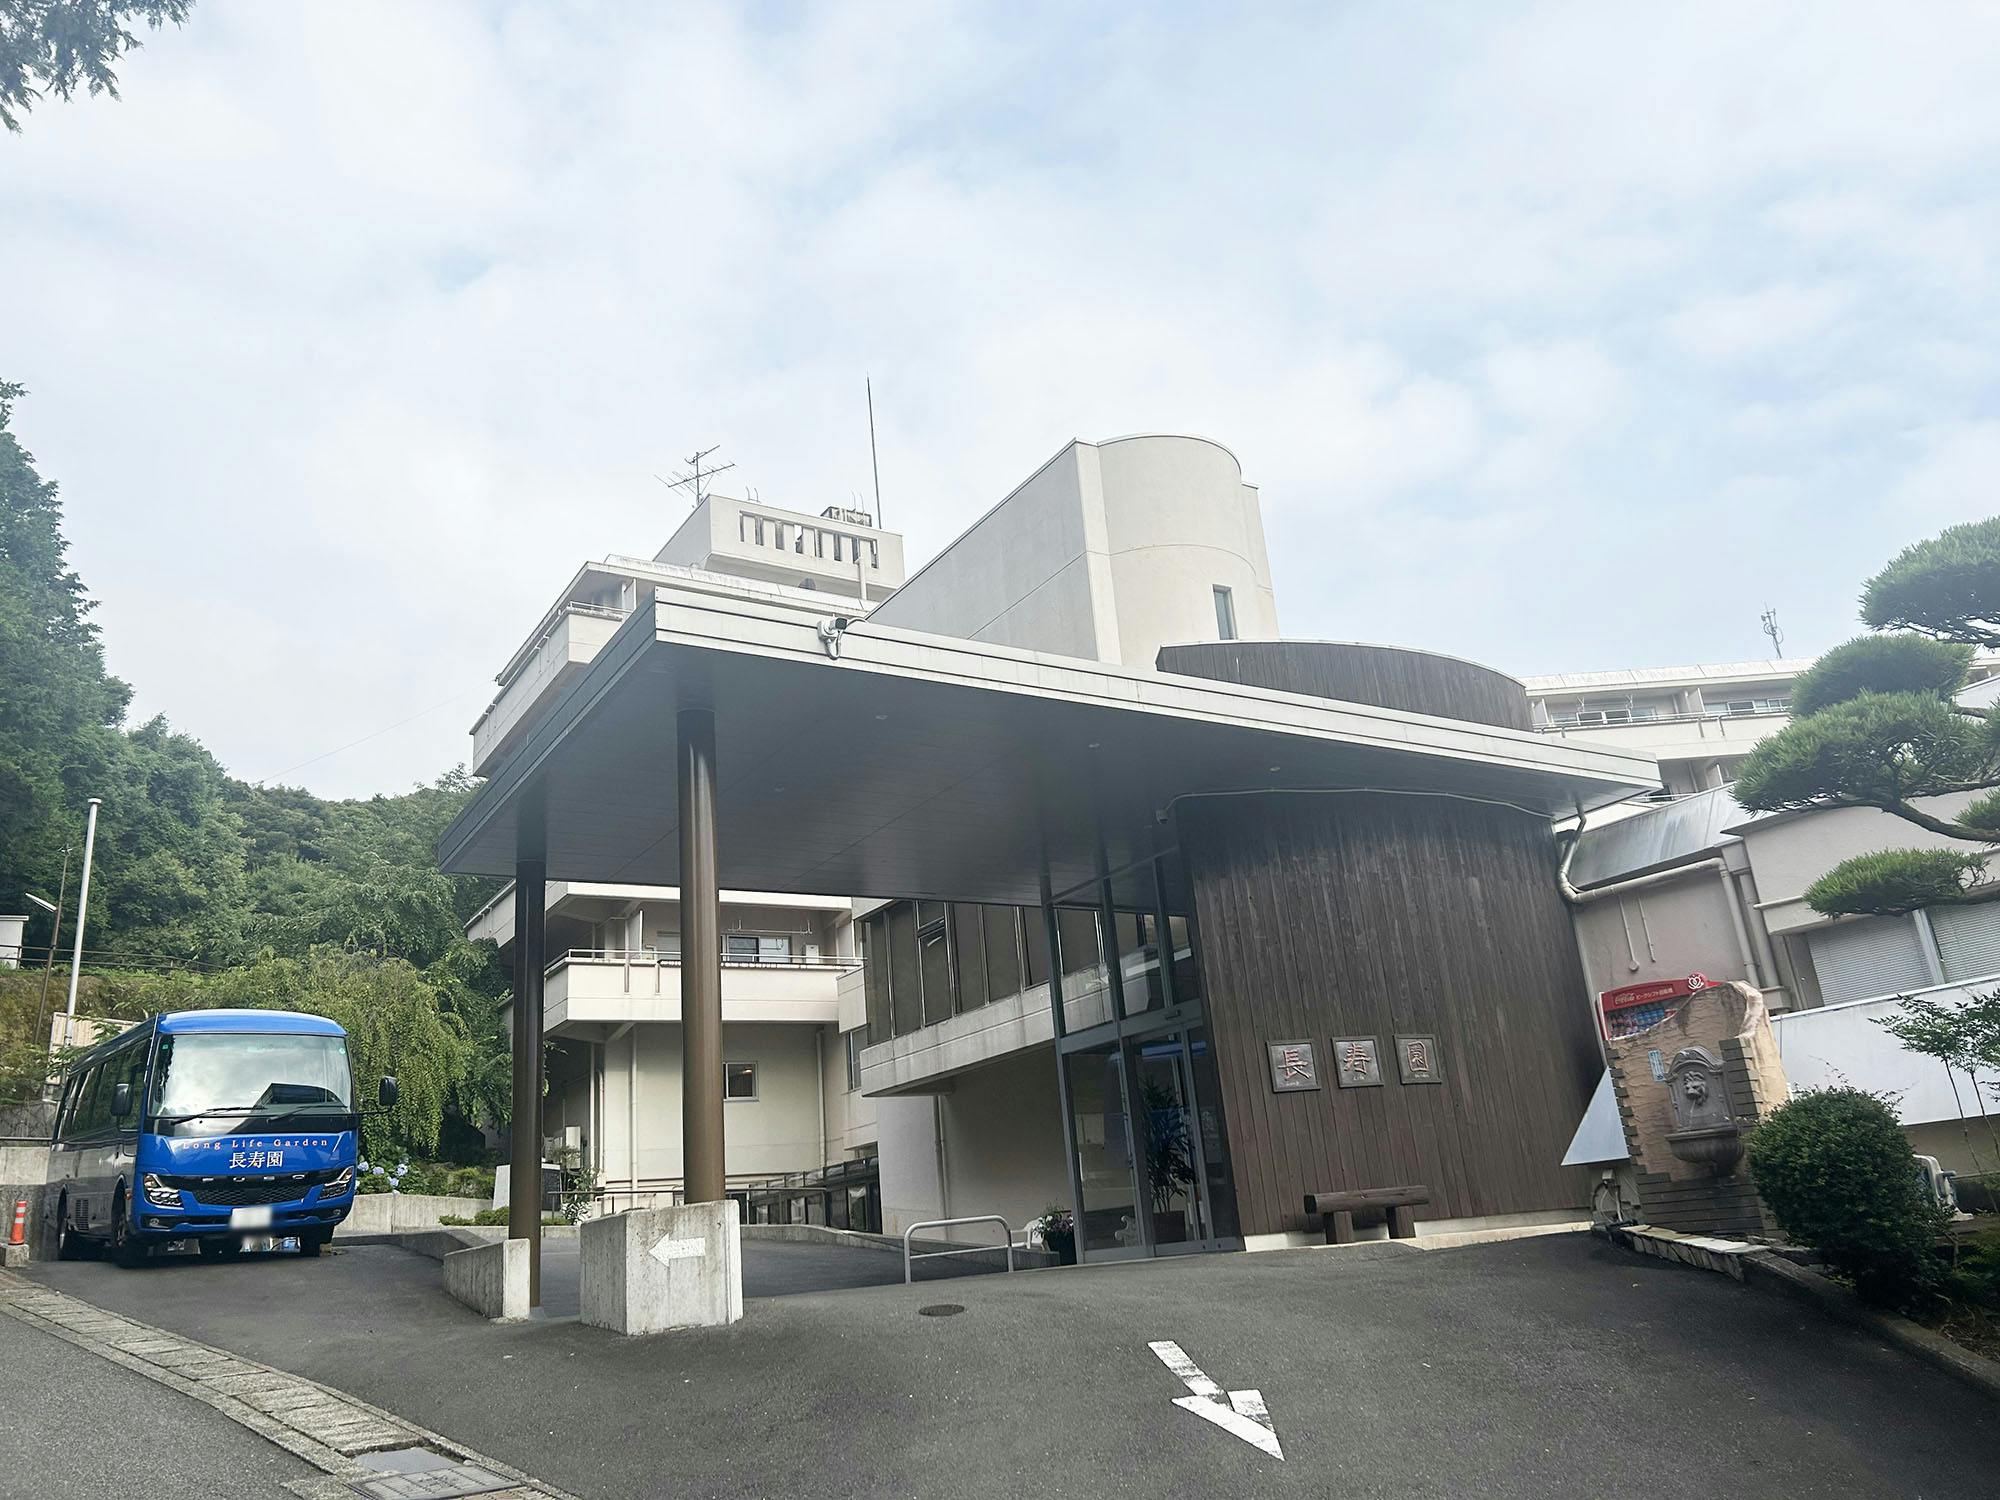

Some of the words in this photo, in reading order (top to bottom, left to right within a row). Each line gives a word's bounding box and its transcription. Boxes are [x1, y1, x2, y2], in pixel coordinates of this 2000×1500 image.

[1277, 1047, 1312, 1081] 長
[183, 1141, 221, 1150] Long
[232, 1139, 263, 1148] Life
[273, 1138, 328, 1147] Garden
[229, 1150, 284, 1169] 長寿園
